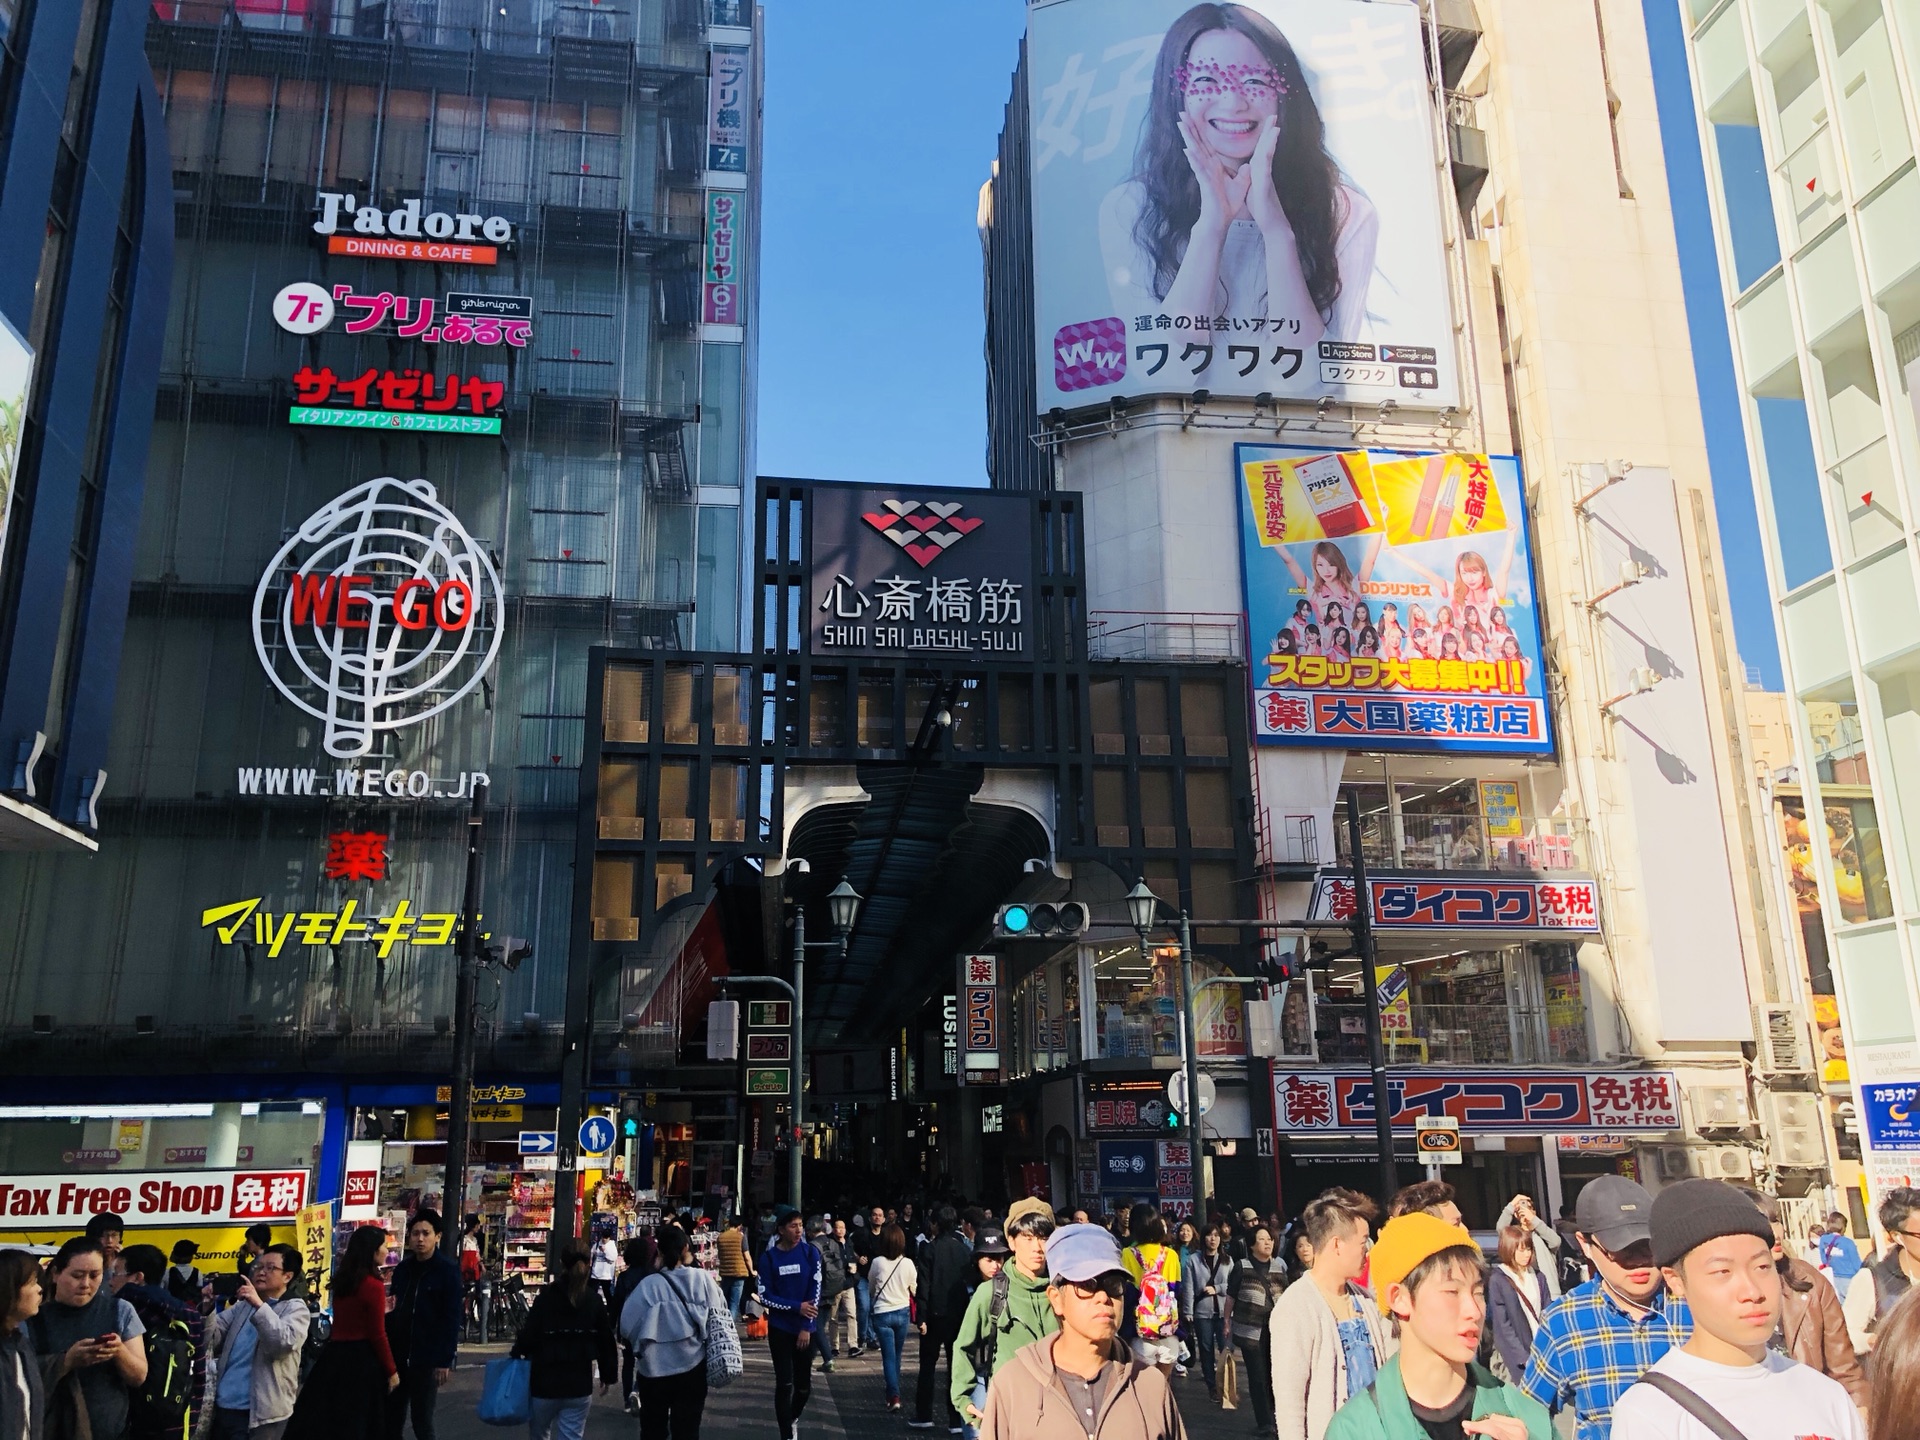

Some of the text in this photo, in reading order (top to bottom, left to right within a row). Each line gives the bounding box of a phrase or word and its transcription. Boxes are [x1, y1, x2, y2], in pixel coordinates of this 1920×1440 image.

[716, 67, 743, 130] プリ機
[717, 148, 739, 165] 7F
[313, 192, 512, 243] J'adore
[346, 240, 473, 261] DINING & CAFE
[713, 197, 734, 280] サイゼリヤ
[287, 294, 324, 324] 7F
[711, 284, 731, 323] 6F
[1134, 313, 1303, 336] 運命の出会いアプリ
[1135, 341, 1305, 381] ワクワク
[1332, 349, 1373, 359] App Store
[1421, 353, 1434, 362] play
[293, 366, 505, 415] サイゼリヤ
[1328, 367, 1386, 382] ワクワク
[1306, 475, 1341, 493] アリナミン
[1262, 463, 1287, 541] 元気激安
[818, 573, 1024, 625] 心斎橋筋
[824, 625, 867, 646] SHIN
[875, 627, 905, 648] SAI
[1264, 693, 1312, 733] 薬
[1321, 698, 1531, 735] 大国薬粧店
[238, 766, 491, 800] WWW.WEGO.JP
[323, 830, 389, 882] 薬
[1379, 885, 1532, 925] ダイコク
[1537, 883, 1595, 917] 免税
[1539, 915, 1597, 928] Tax-Free
[969, 955, 992, 984] 薬
[943, 994, 957, 1048] LUSH
[970, 990, 992, 1047] ダイコク
[1211, 1023, 1238, 1041] 380
[1380, 1013, 1408, 1029] 158
[1284, 1075, 1332, 1128] 薬
[1346, 1081, 1582, 1122] ダイコク
[1590, 1076, 1674, 1112] 免税
[1594, 1111, 1676, 1127] Tax-Free
[1108, 1159, 1130, 1169] BOSS
[1166, 1142, 1190, 1166] 薬
[0, 1180, 225, 1217] Tax Free Shop
[234, 1176, 300, 1215] 免税
[347, 1176, 375, 1192] SK-II
